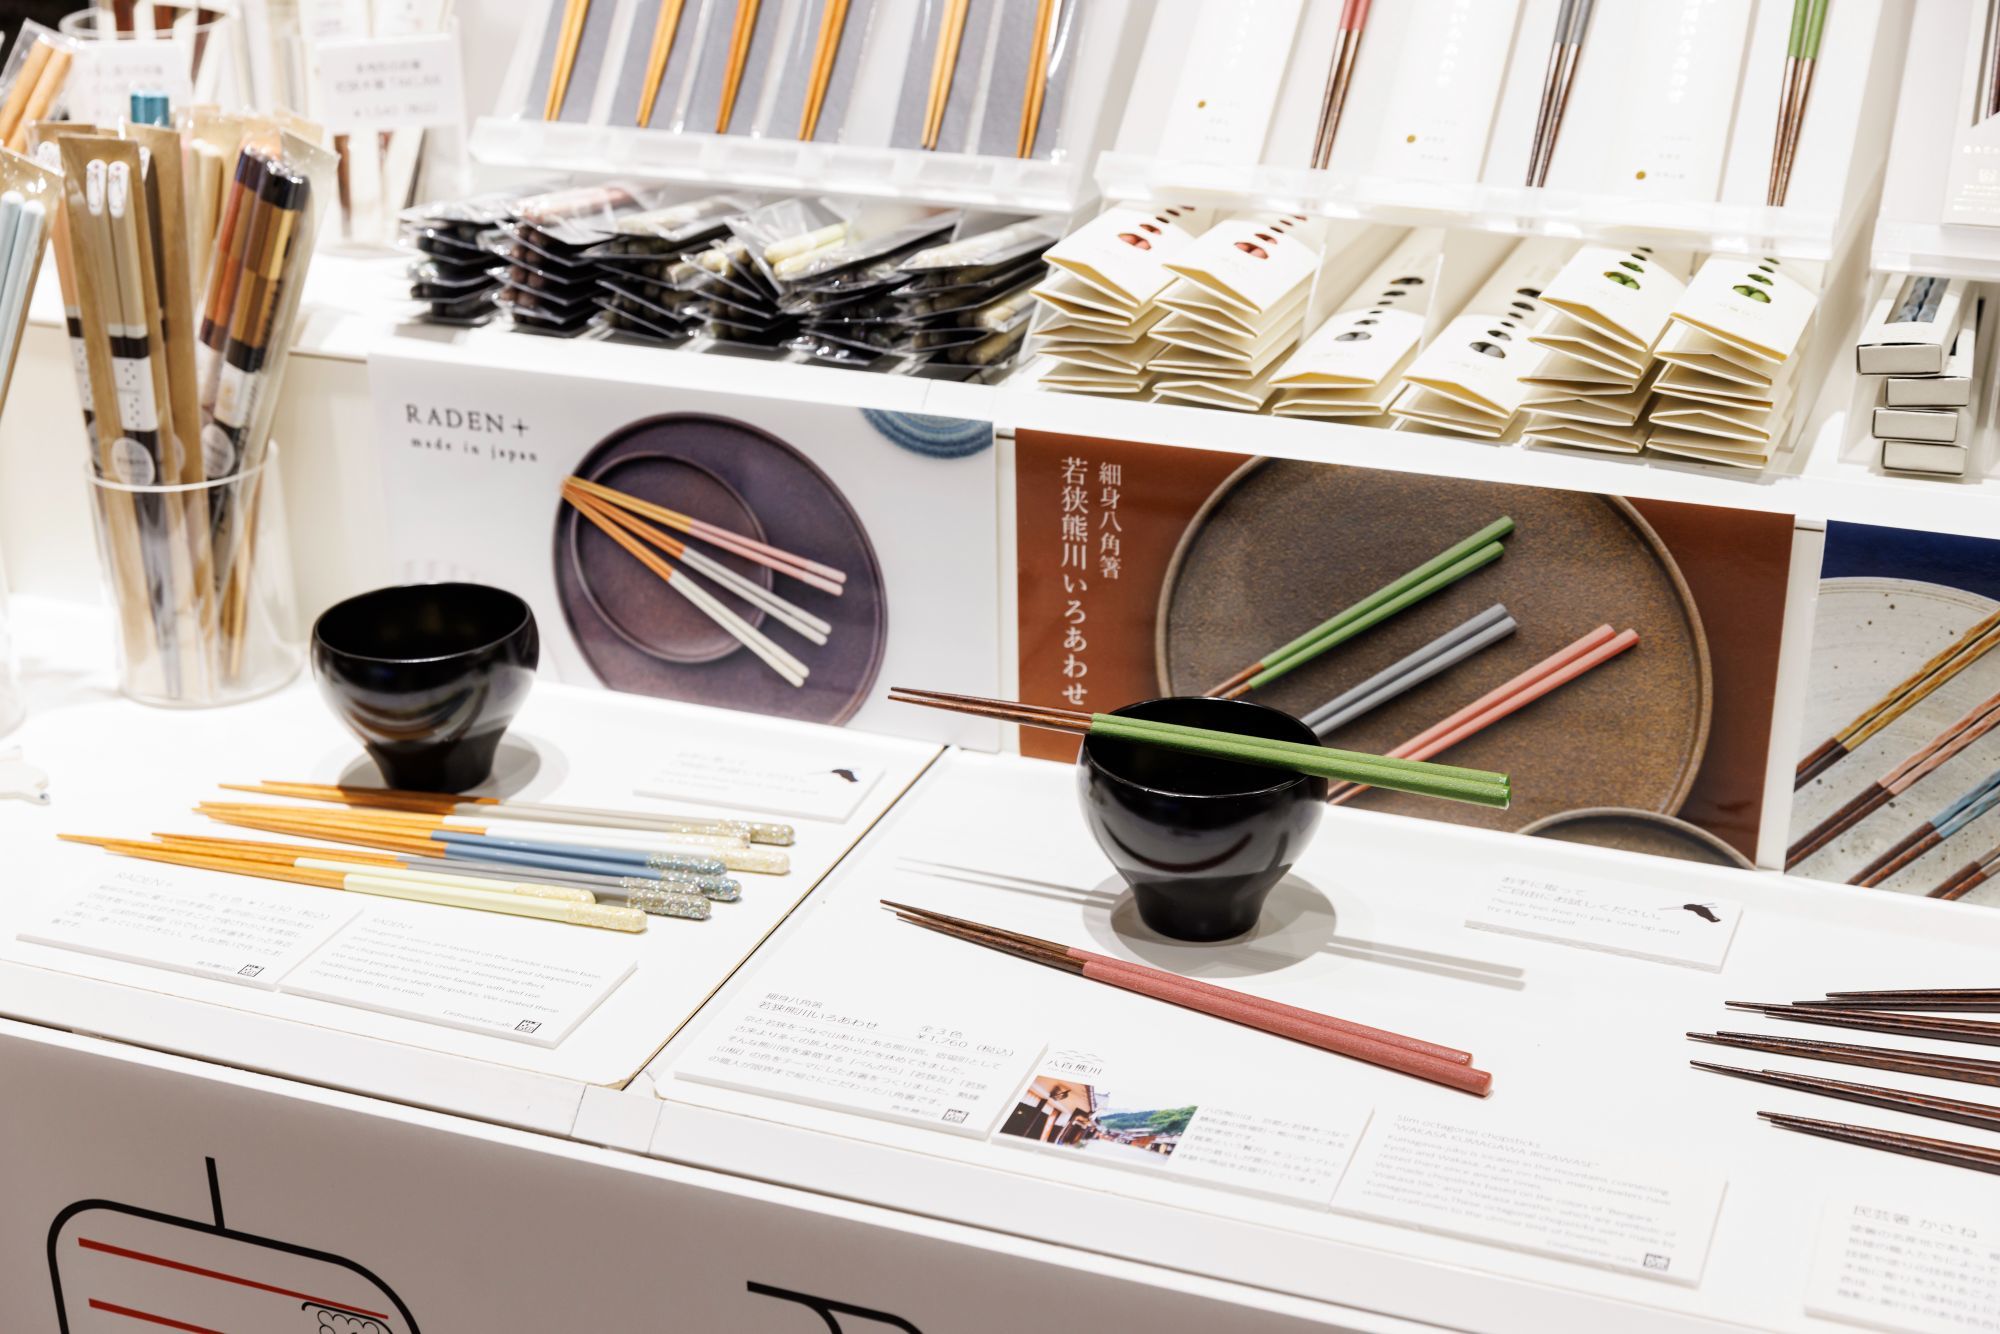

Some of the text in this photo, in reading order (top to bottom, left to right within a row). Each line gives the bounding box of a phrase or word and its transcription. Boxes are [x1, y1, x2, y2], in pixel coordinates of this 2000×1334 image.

[405, 403, 529, 437] RADEN+
[411, 437, 538, 464] made in japan
[1098, 462, 1122, 580] 細身八角箸
[1060, 456, 1089, 706] 若狭熊川いろあわせ
[1396, 1114, 1541, 1149] Slim octagonal chopsticks
[1919, 1219, 1978, 1239] かさね
